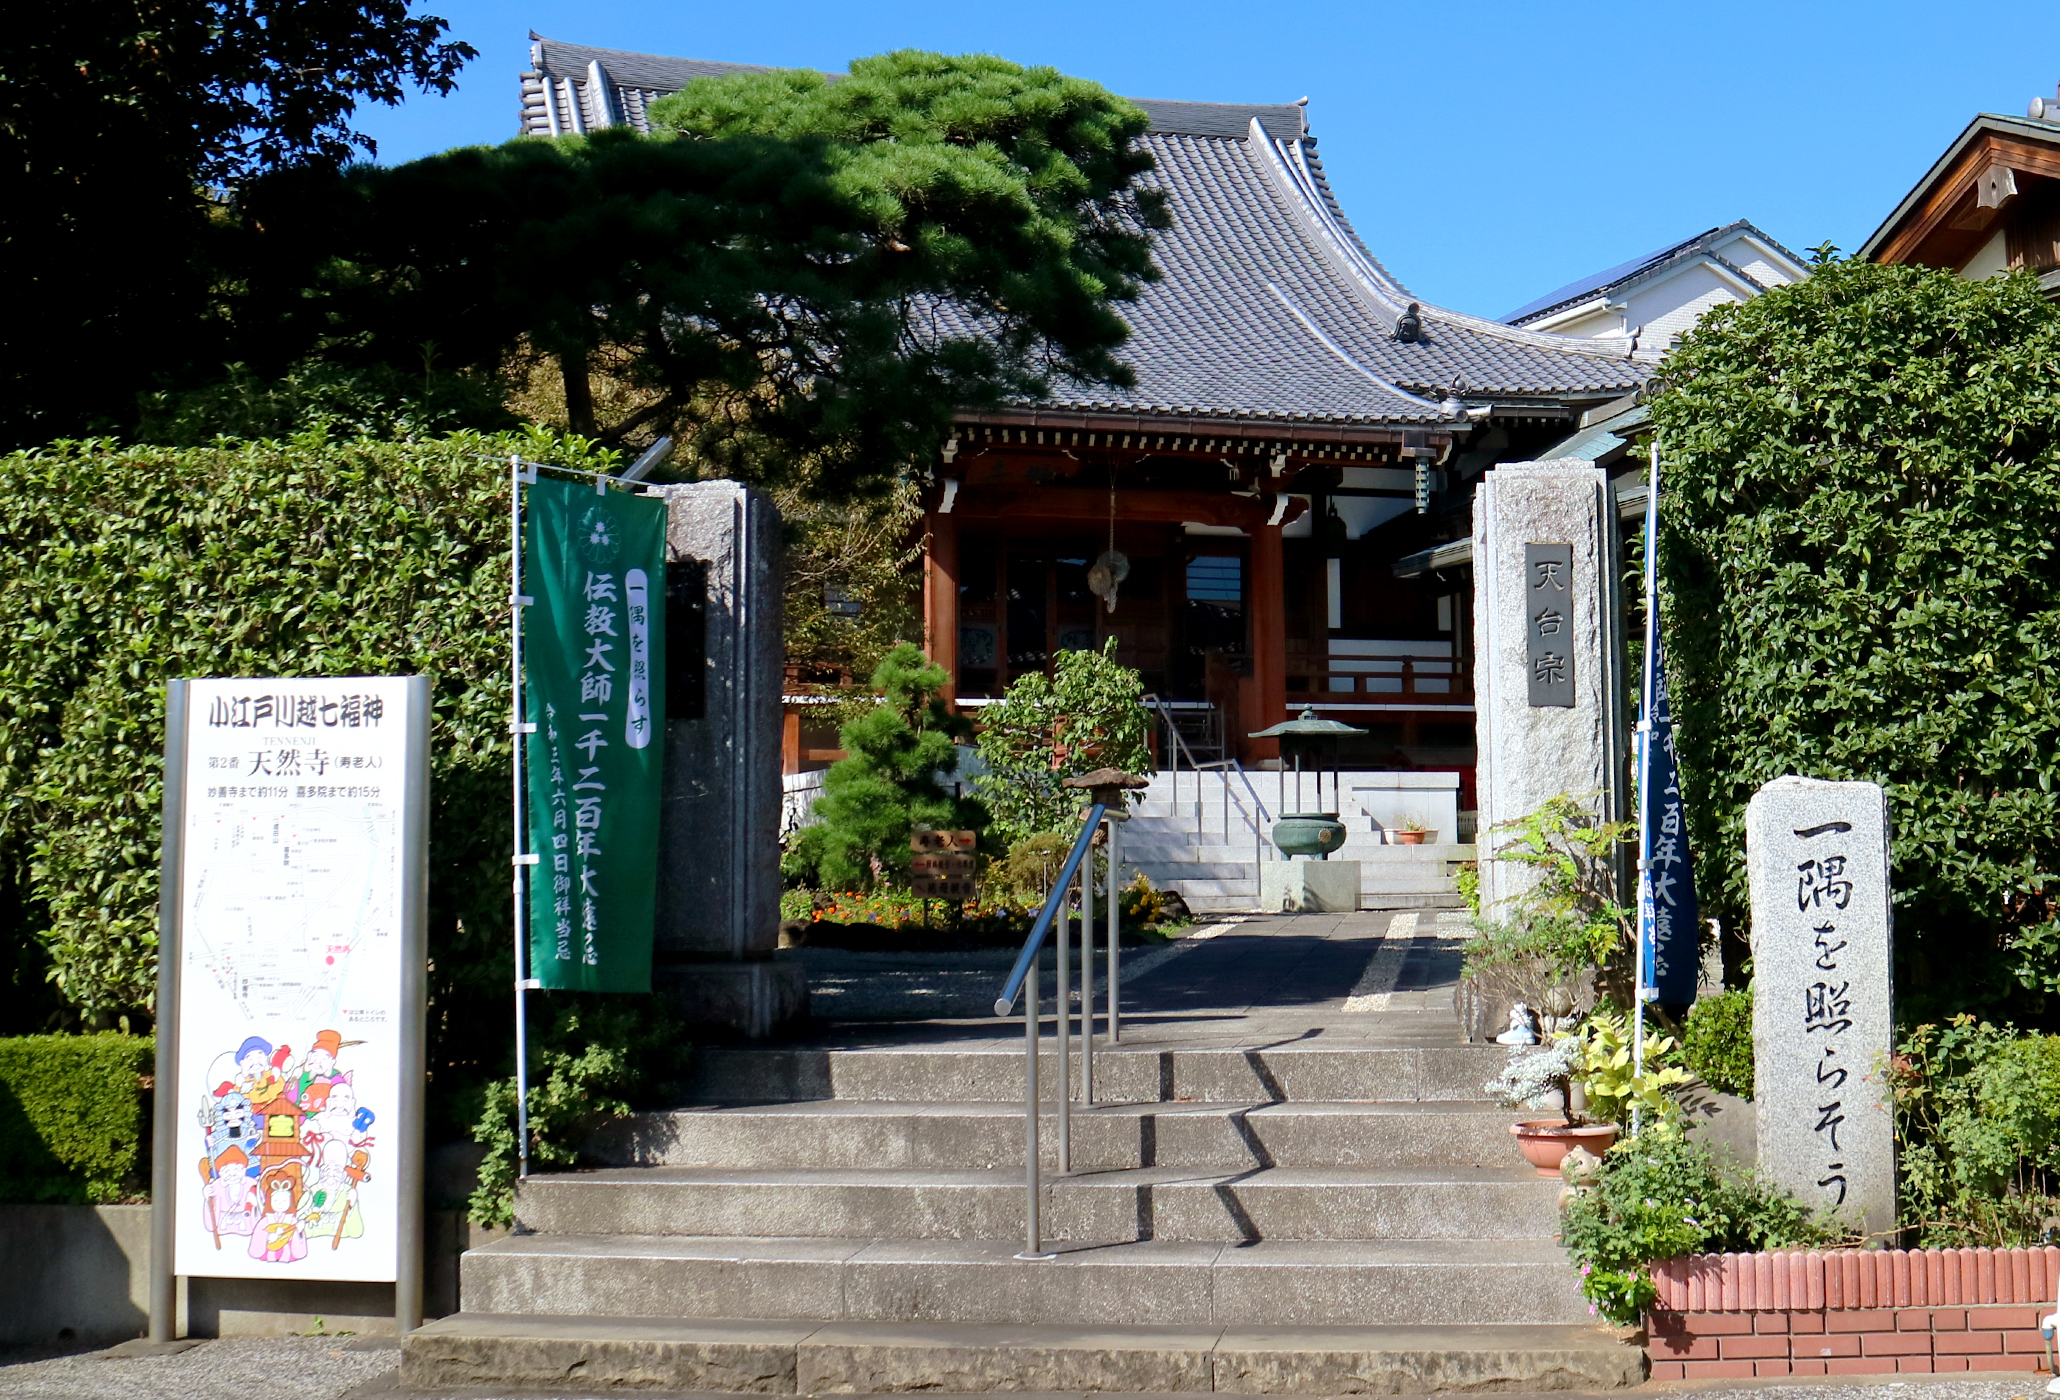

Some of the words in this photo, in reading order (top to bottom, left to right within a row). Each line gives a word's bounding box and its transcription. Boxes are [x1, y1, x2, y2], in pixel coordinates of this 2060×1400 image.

[1533, 560, 1566, 685] 天台宗
[629, 585, 648, 736] 一隅を照らす
[209, 693, 384, 729] 小江戸川越七福神
[263, 736, 317, 747] TENNENJI
[208, 756, 240, 770] 第2番
[246, 748, 331, 778] 天然寺
[207, 785, 289, 799] 妙善寺まで約11分
[295, 785, 382, 799] 喜多院まで約15分
[1793, 820, 1854, 1215] 一隅を照らそう
